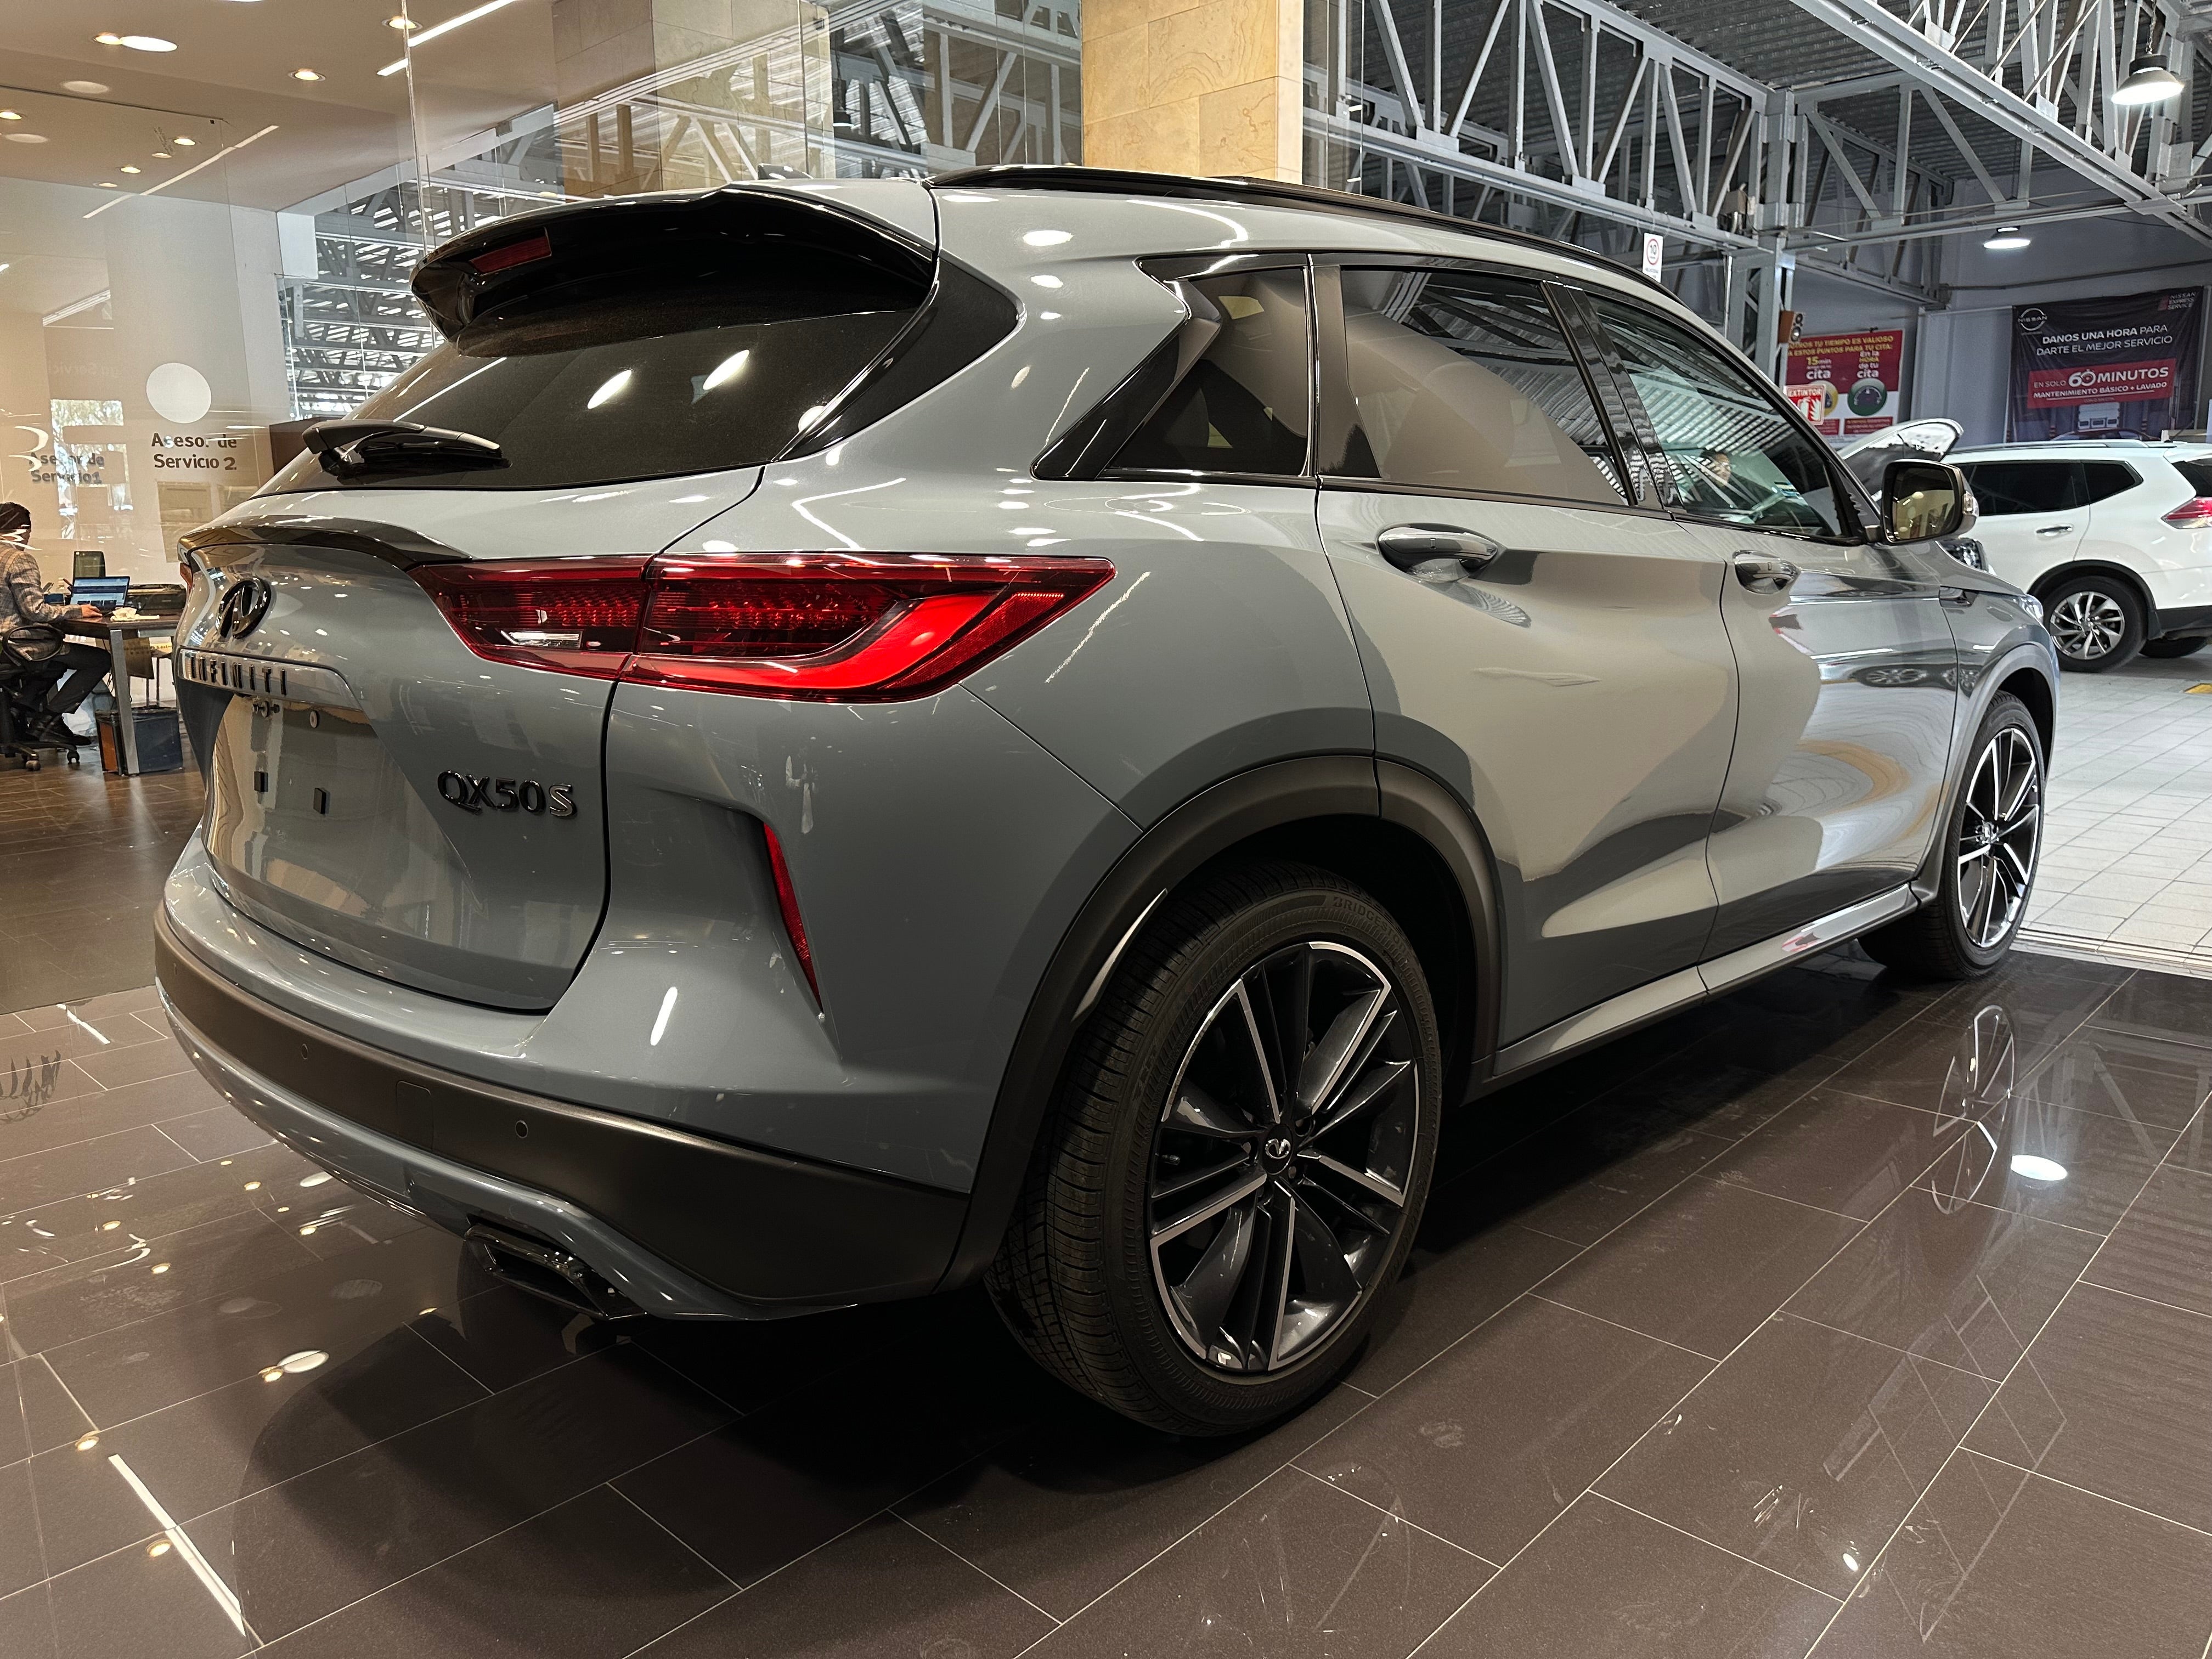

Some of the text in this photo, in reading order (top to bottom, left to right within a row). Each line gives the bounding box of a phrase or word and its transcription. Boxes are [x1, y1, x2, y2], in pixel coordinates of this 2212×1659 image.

[1862, 335, 1894, 343] VALIOSO
[2042, 324, 2168, 345] DANOS UNA HORA PARA
[2036, 335, 2172, 356] DARTE EL MEJOR SERVICIO
[1806, 368, 1831, 380] cita
[1857, 368, 1879, 379] cita
[2097, 366, 2169, 383] MINUTOS
[2033, 388, 2097, 399] MANTENIMIENTO
[2099, 385, 2128, 394] BÁSICO
[2136, 381, 2167, 390] LAVADO
[218, 434, 237, 448] de
[153, 454, 219, 469] Servicio
